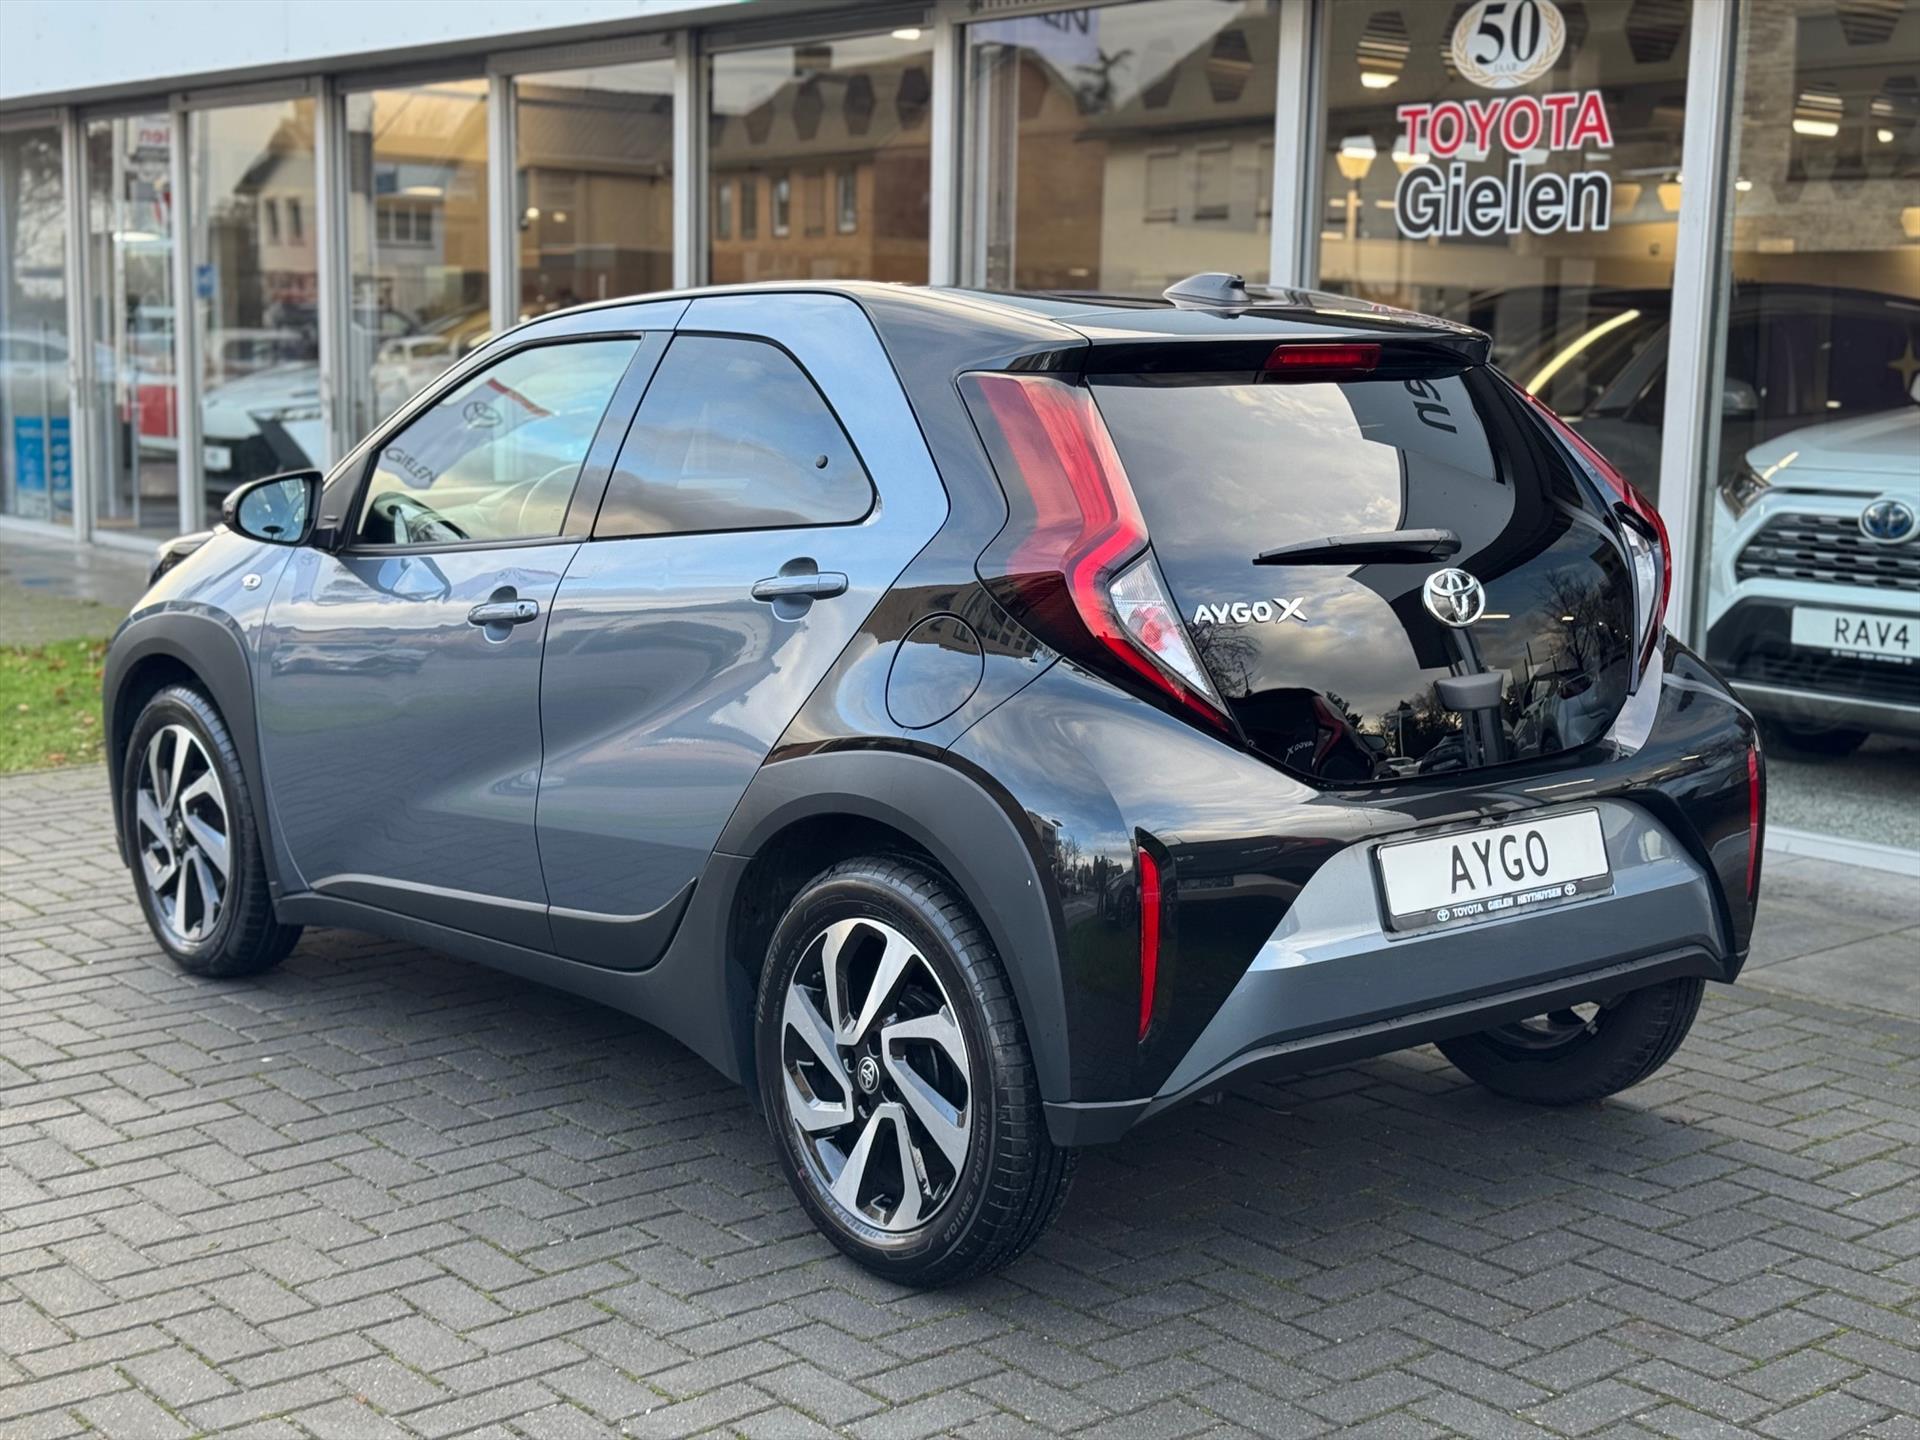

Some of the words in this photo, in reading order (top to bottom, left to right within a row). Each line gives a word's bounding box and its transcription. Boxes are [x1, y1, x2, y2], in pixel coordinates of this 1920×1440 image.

[1475, 0, 1541, 65] 50
[1397, 90, 1613, 158] TOYOTA
[1395, 159, 1612, 239] Gielen
[384, 447, 439, 482] GIELEN
[1192, 600, 1272, 625] AYGO
[1834, 617, 1910, 650] RAV4
[1450, 829, 1549, 894] AYGO
[1452, 904, 1484, 919] TOYOTA
[1487, 897, 1514, 911] GIELEN
[971, 1102, 989, 1186] SINCERA
